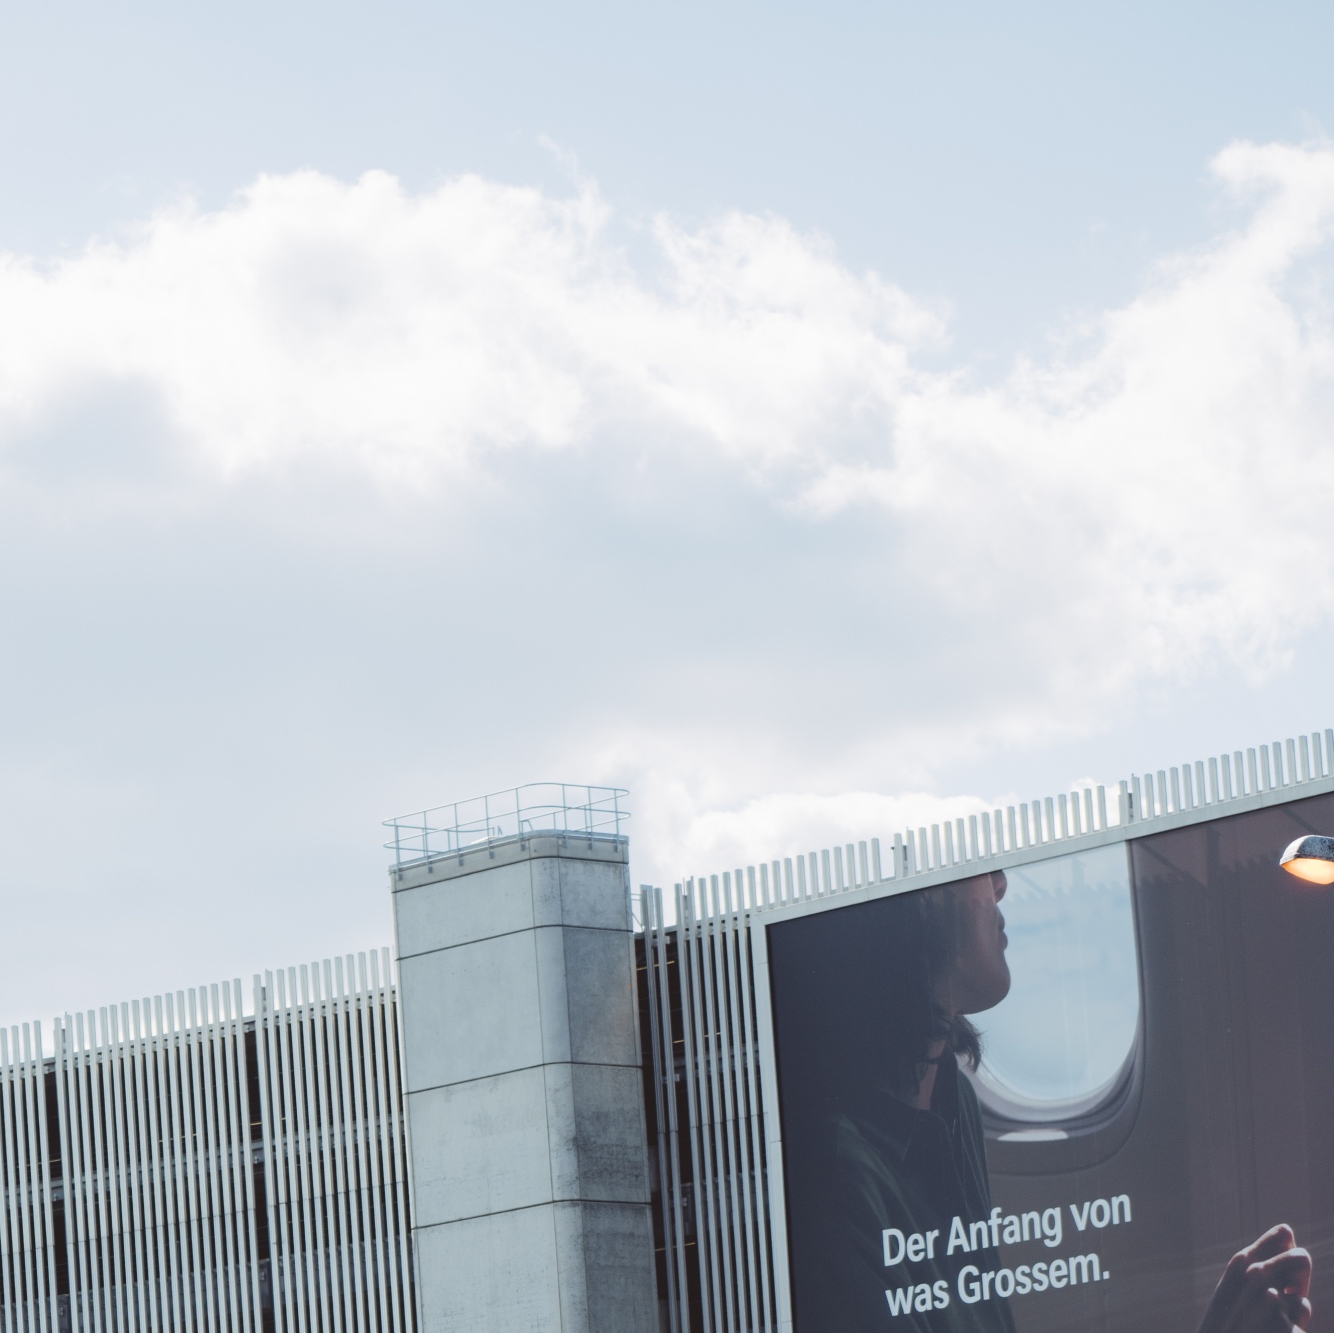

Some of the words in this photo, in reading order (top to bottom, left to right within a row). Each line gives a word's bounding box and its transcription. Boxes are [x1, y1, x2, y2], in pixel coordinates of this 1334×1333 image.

[882, 1227, 939, 1267] Der
[946, 1206, 1062, 1255] Anfang
[1069, 1194, 1132, 1232] von
[885, 1279, 950, 1317] was
[957, 1252, 1110, 1304] Grossem.
